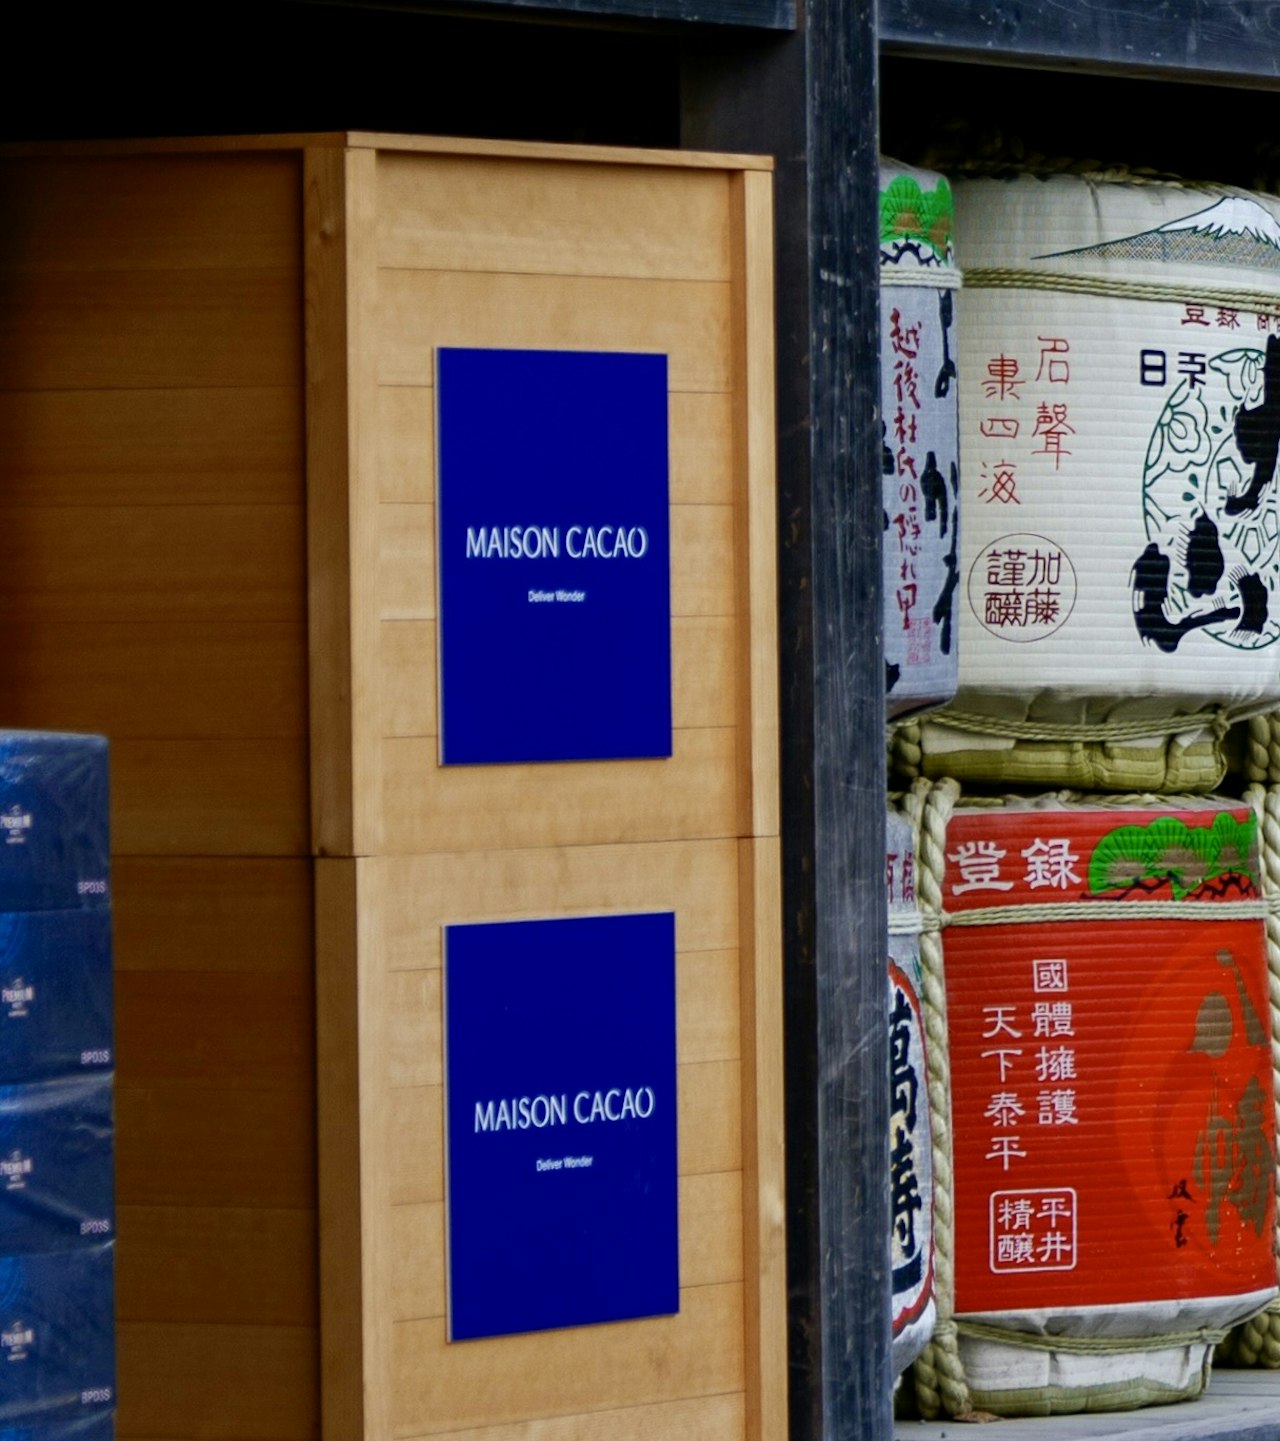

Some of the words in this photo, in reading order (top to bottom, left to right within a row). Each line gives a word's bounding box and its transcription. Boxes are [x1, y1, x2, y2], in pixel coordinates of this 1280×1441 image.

[465, 526, 560, 560] MAISON
[565, 526, 648, 560] CACAO
[947, 838, 1083, 896] 登録
[474, 1096, 567, 1133] MAISON
[573, 1086, 656, 1124] CACAO
[981, 1005, 1028, 1172] 天下泰平
